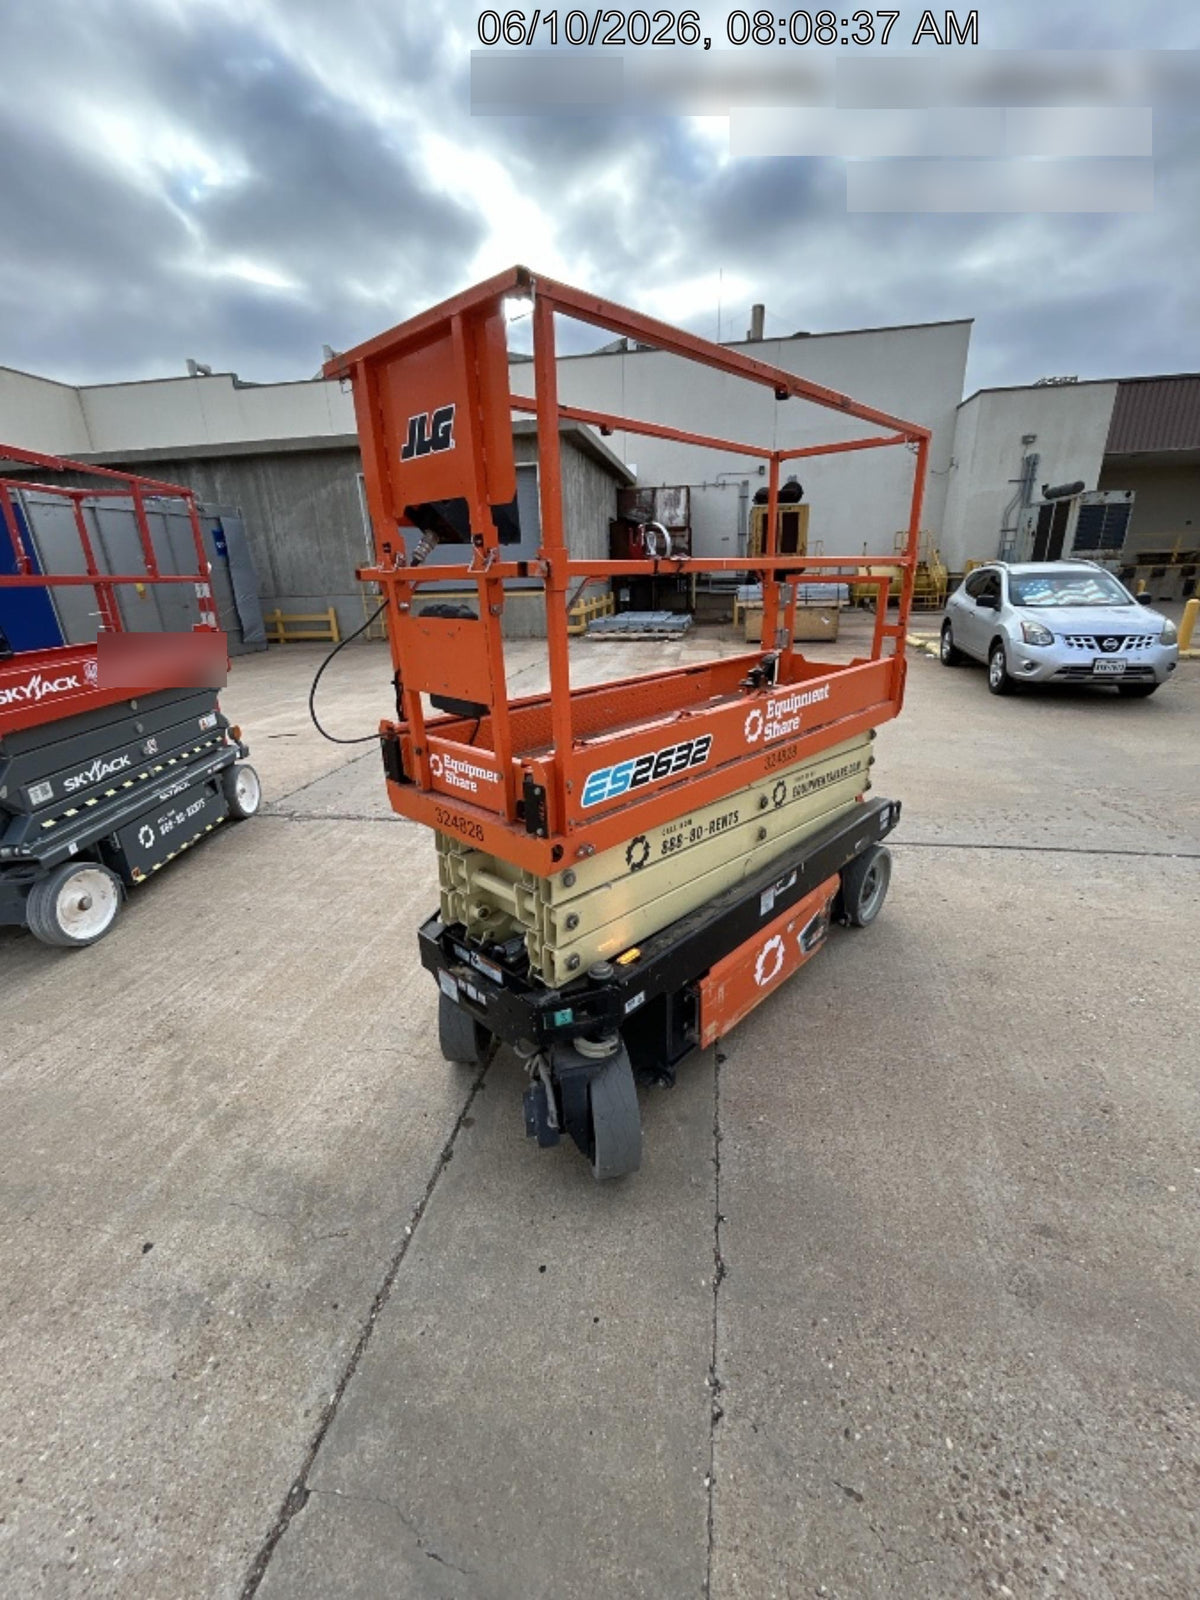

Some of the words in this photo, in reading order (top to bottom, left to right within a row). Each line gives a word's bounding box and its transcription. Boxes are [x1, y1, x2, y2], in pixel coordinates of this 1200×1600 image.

[400, 403, 455, 462] JLG
[0, 674, 81, 705] SKYJACK
[766, 683, 830, 719] Equipment
[764, 716, 801, 741] Share
[63, 756, 131, 792] SKYJACK
[443, 754, 498, 784] Equipme
[445, 771, 479, 793] Share
[581, 734, 713, 807] ES2632
[434, 806, 484, 842] 324828
